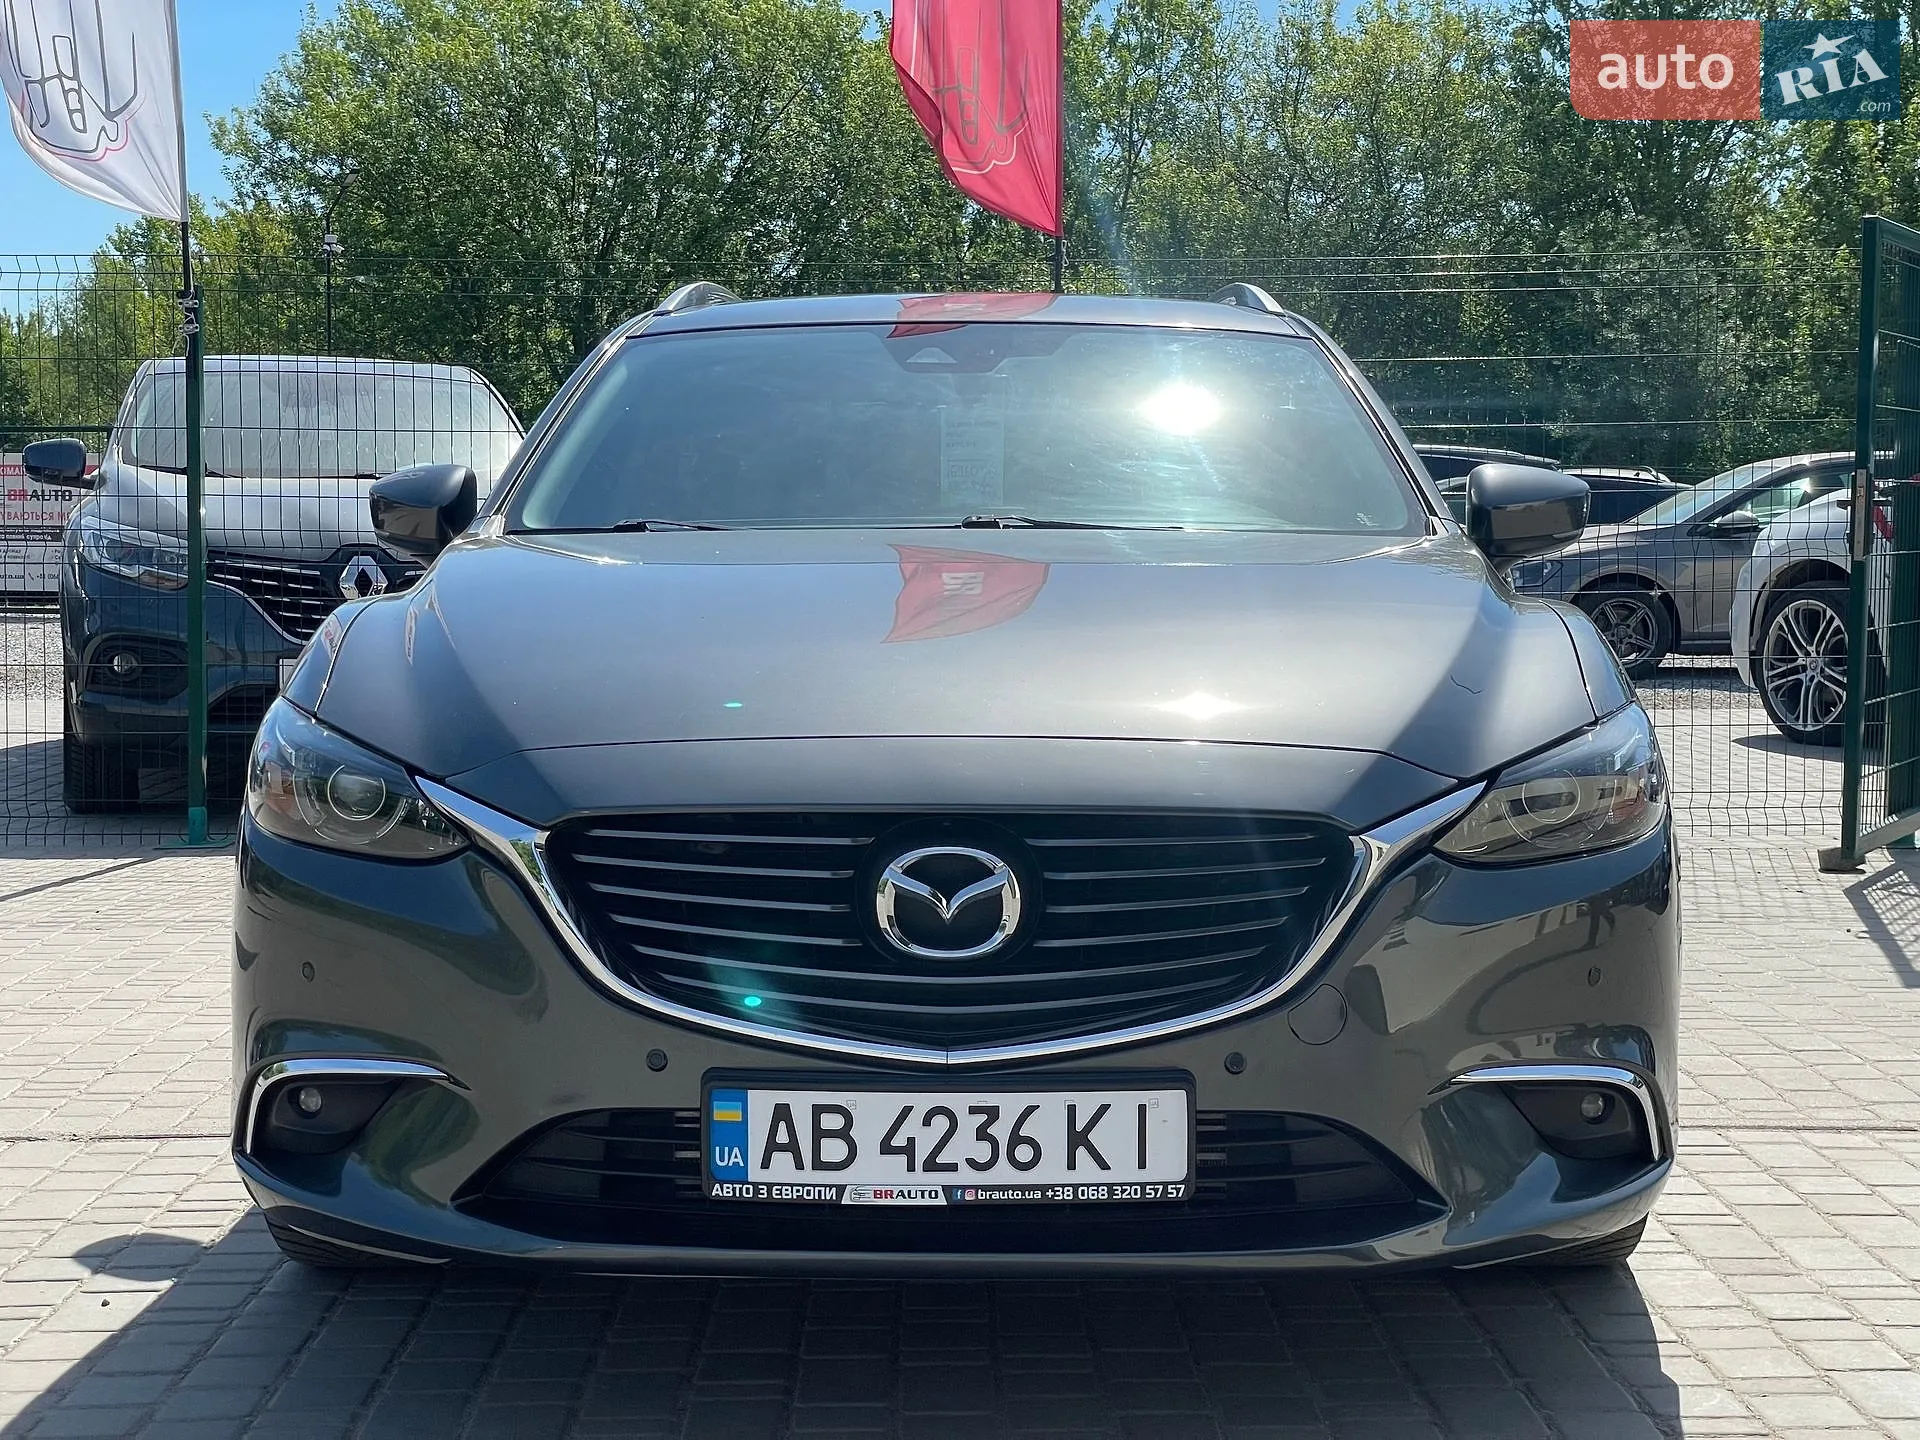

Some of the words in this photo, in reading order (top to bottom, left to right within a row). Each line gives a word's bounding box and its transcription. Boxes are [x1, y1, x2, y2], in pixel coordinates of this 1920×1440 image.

[7, 489, 73, 502] BRAUTO
[760, 1103, 858, 1171] AB
[879, 1104, 1043, 1173] 4236
[715, 1147, 744, 1167] UA
[711, 1183, 751, 1198] АВТО
[772, 1185, 837, 1200] ЄВРОПИ
[873, 1189, 939, 1200] BRAUTO
[977, 1188, 1042, 1200] brauto.ua
[1045, 1186, 1074, 1200] +38
[1078, 1186, 1109, 1199] 068
[1113, 1185, 1141, 1199] 320
[1145, 1184, 1163, 1198] 57
[1167, 1184, 1185, 1198] 57
